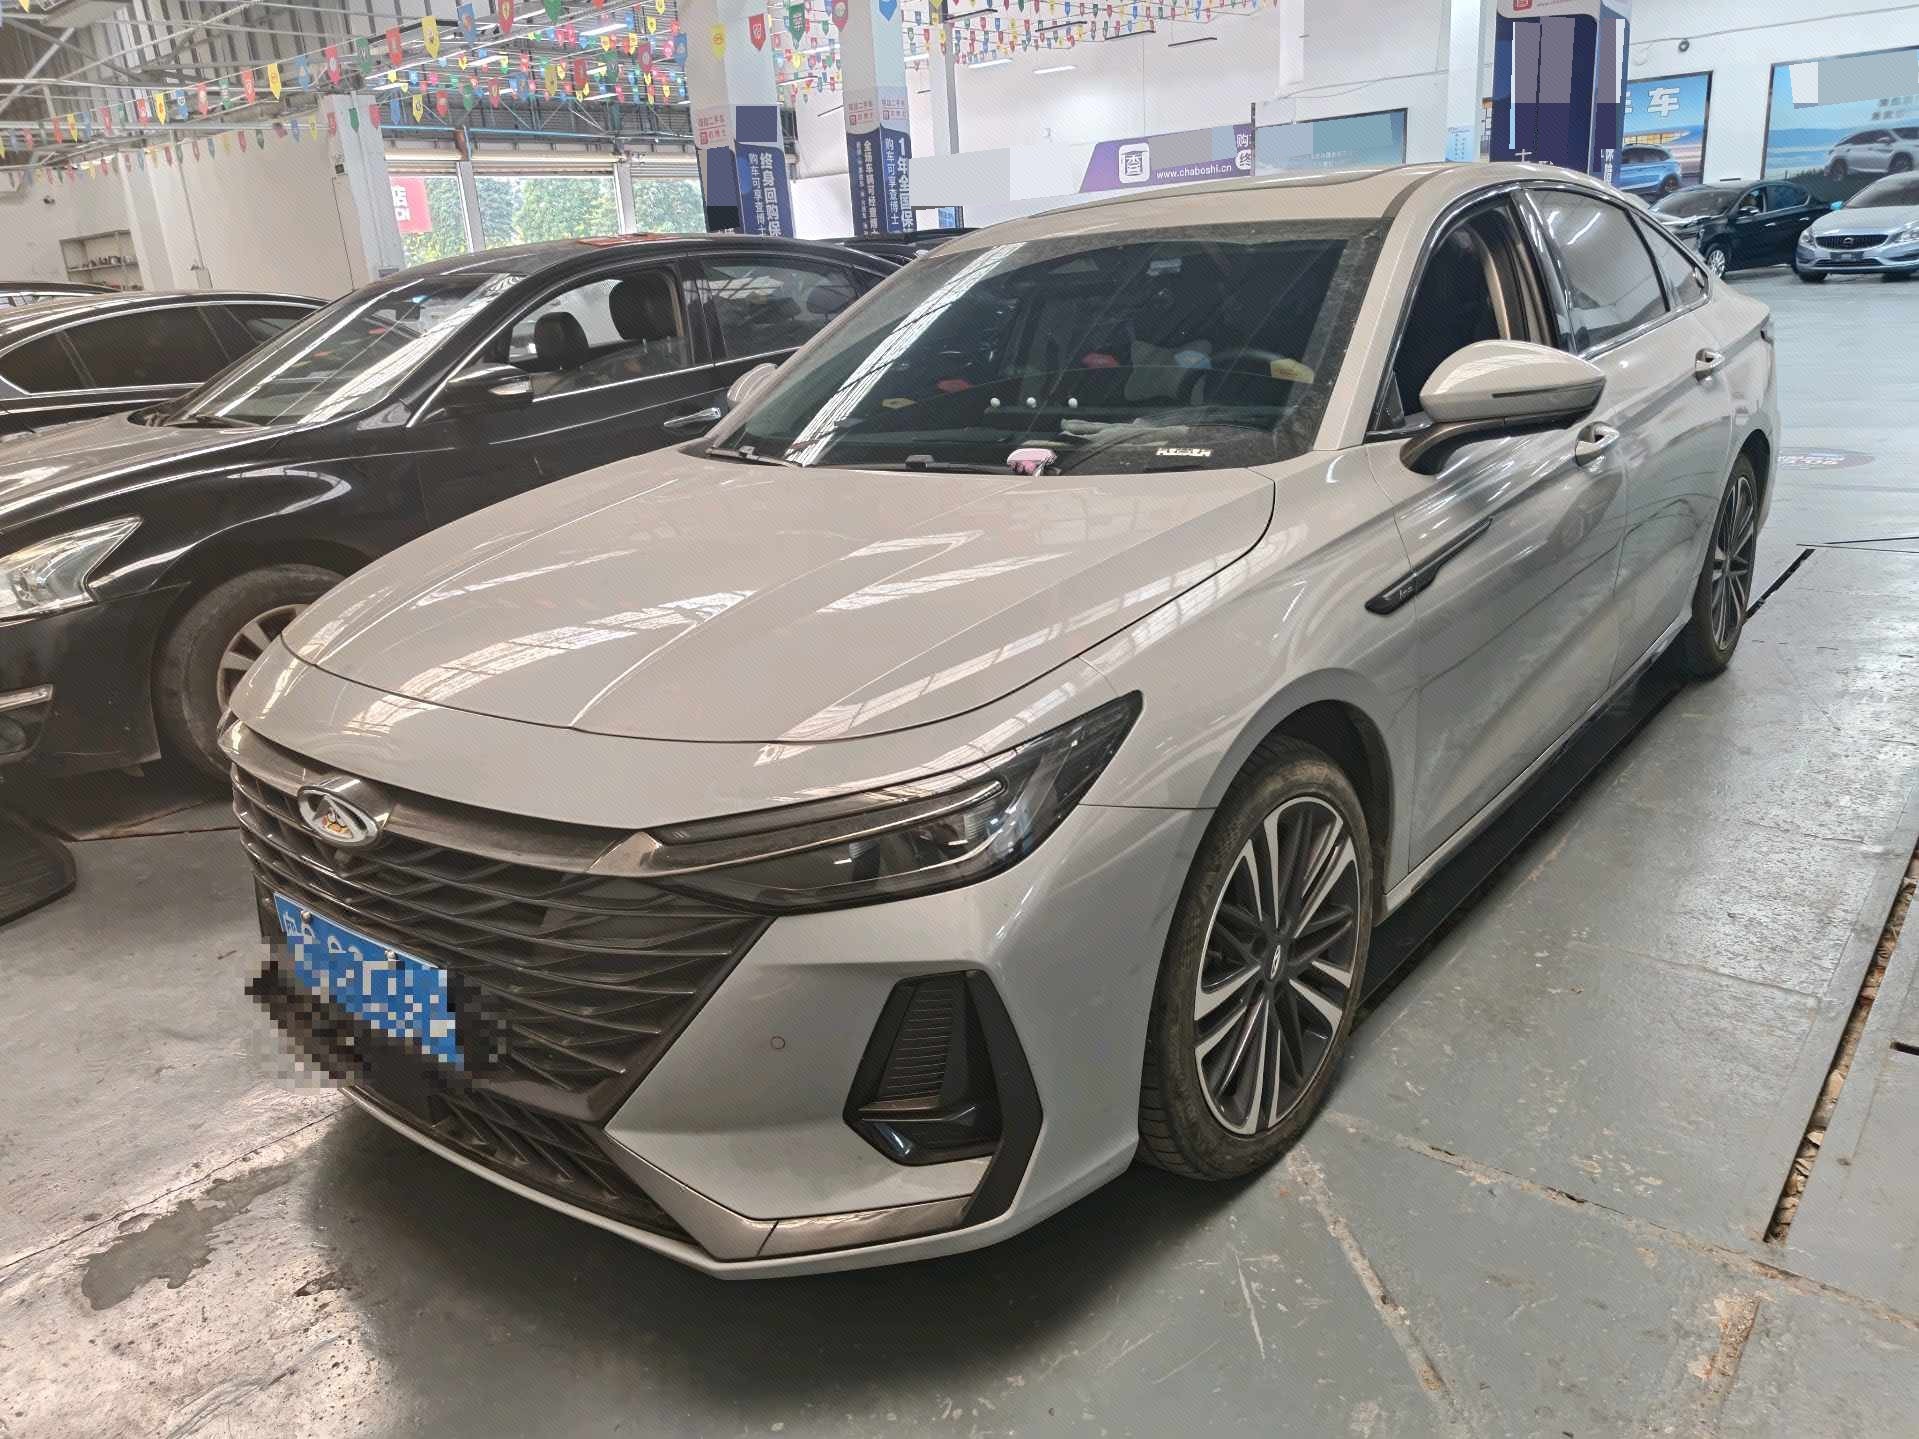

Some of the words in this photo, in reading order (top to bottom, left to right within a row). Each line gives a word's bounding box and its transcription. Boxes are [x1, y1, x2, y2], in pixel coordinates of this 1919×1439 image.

[1625, 87, 1679, 117] 车
[1236, 133, 1252, 149] 购
[1156, 164, 1232, 179] www.chaboshi.cn
